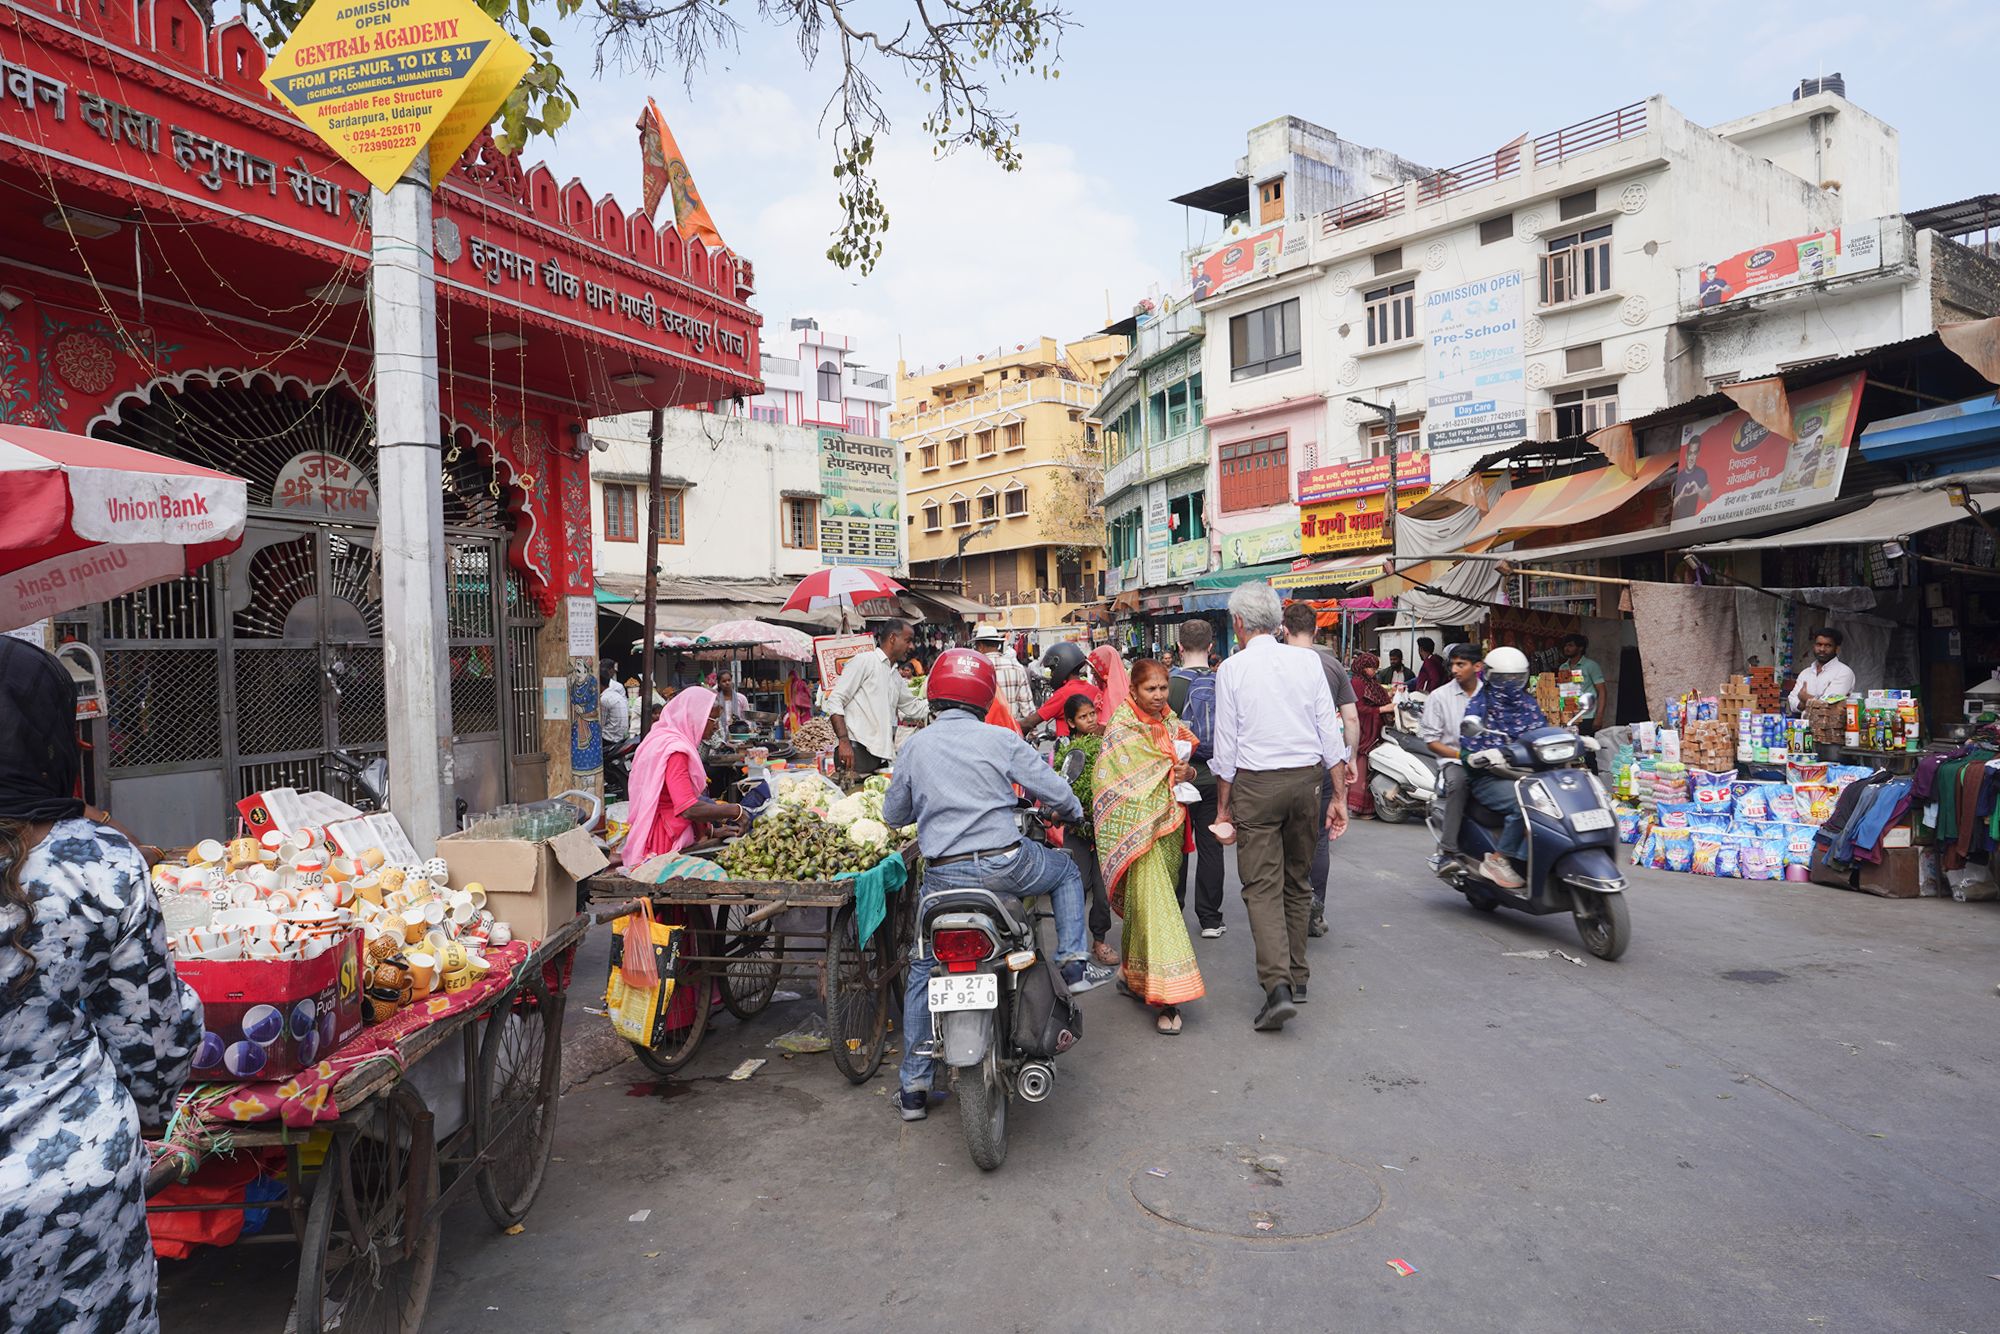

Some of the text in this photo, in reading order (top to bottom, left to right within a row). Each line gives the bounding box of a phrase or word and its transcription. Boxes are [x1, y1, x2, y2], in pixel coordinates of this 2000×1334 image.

[336, 0, 411, 20] ADMISSION
[355, 13, 392, 30] OPEN
[294, 18, 460, 67] CENTRAL ACADEMY
[288, 46, 472, 91] FROM PRE-NUR. TO IX & XI
[306, 67, 453, 101] (SCIENCE, COMMERCE, HUMANITIES)
[318, 86, 443, 118] Affordable Fee Structure
[328, 104, 433, 130] Sardarpura, Udaipur
[352, 122, 422, 142] 0294-2526170
[77, 89, 161, 153] दाता
[168, 123, 278, 196] हनुमान
[282, 155, 341, 216] सेवा
[358, 136, 417, 154] 7239902223
[1850, 234, 1871, 244] SHREE
[1850, 244, 1874, 253] KIRANA
[1282, 244, 1308, 257] COMPANY
[1850, 249, 1871, 258] STORE
[470, 235, 537, 286] हनुमान
[543, 257, 580, 300] चौक
[584, 279, 616, 315] धान
[619, 291, 658, 329] मण्डी
[660, 306, 712, 353] उदयपुर
[1428, 273, 1521, 308] ADMISSION OPEN
[1433, 318, 1517, 346] Pre-School
[1434, 392, 1466, 405] Nursery
[1458, 402, 1491, 415] Day Care
[1498, 430, 1521, 438] Udaipur
[823, 436, 893, 458] ओसवाल
[106, 491, 209, 525] Union Bank
[1700, 498, 1796, 524] SATYA NARAYAN GENERAL STORE
[186, 518, 215, 532] India
[1301, 514, 1316, 538] माँ
[1318, 512, 1346, 536] राणी
[340, 954, 358, 1000] SP
[966, 976, 983, 990] 27
[930, 993, 948, 1006] SF
